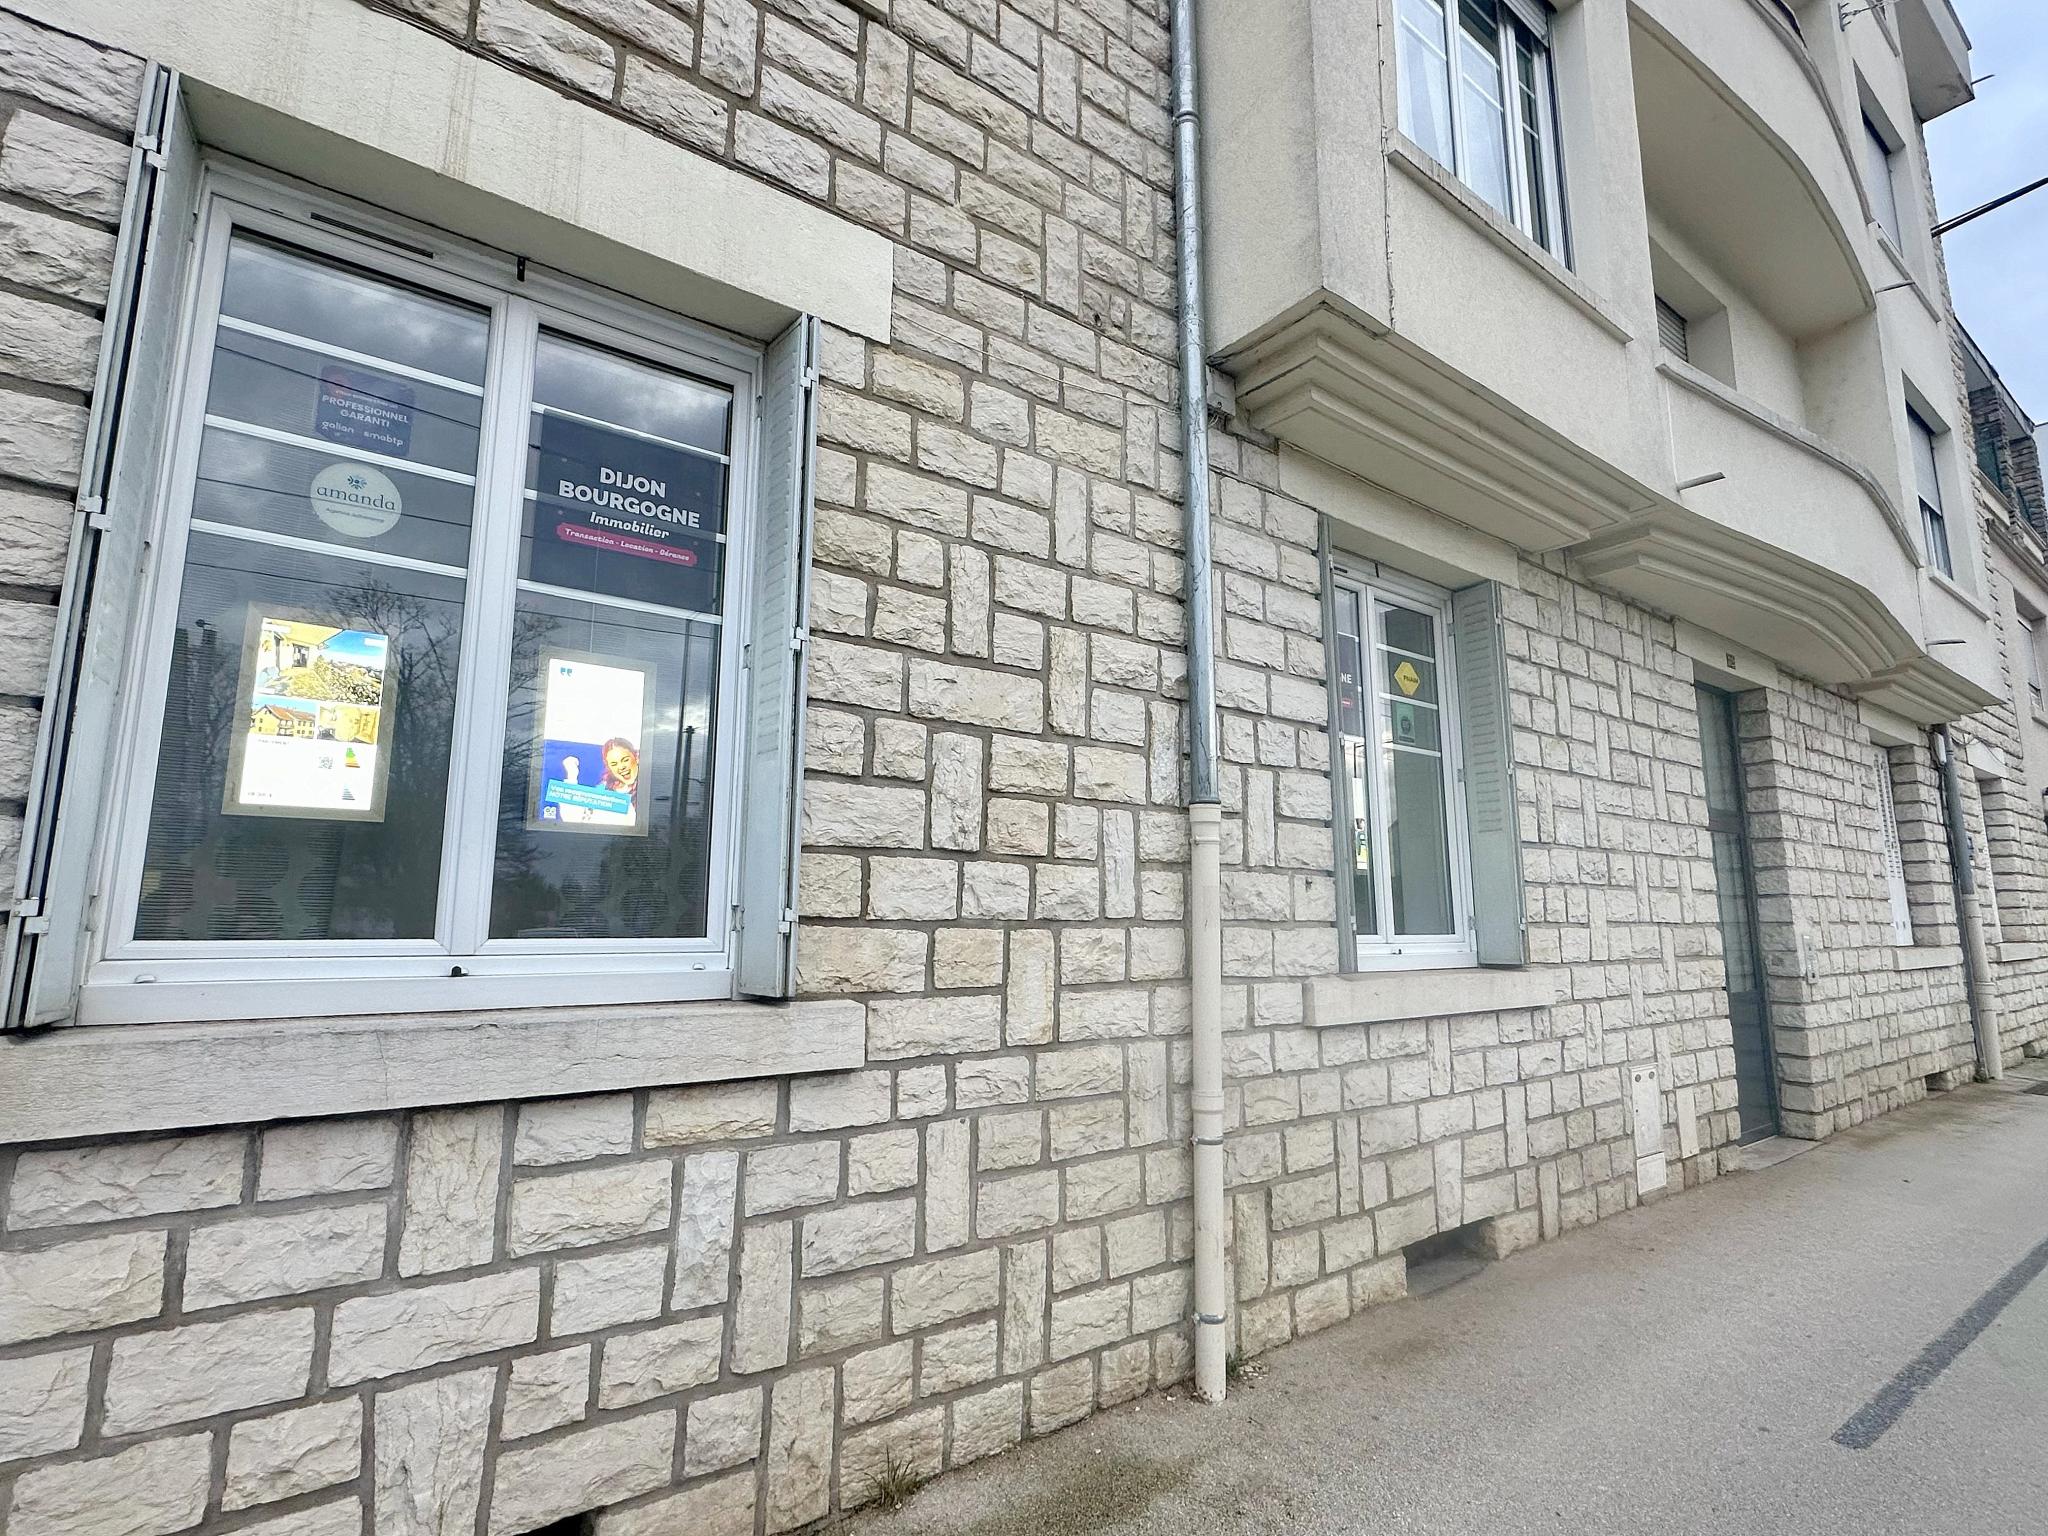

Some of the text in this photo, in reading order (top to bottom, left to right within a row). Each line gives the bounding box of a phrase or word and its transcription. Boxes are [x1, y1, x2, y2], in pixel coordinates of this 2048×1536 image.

[322, 395, 409, 423] PROFESSIONNEL
[340, 409, 390, 428] GARANTI
[363, 431, 404, 446] smabtp
[600, 467, 666, 498] DIJON
[316, 486, 395, 510] amanda
[558, 480, 700, 528] BOURGOGNE
[590, 512, 669, 539] Immobilier
[565, 528, 614, 545] Transaction
[620, 540, 654, 553] Location
